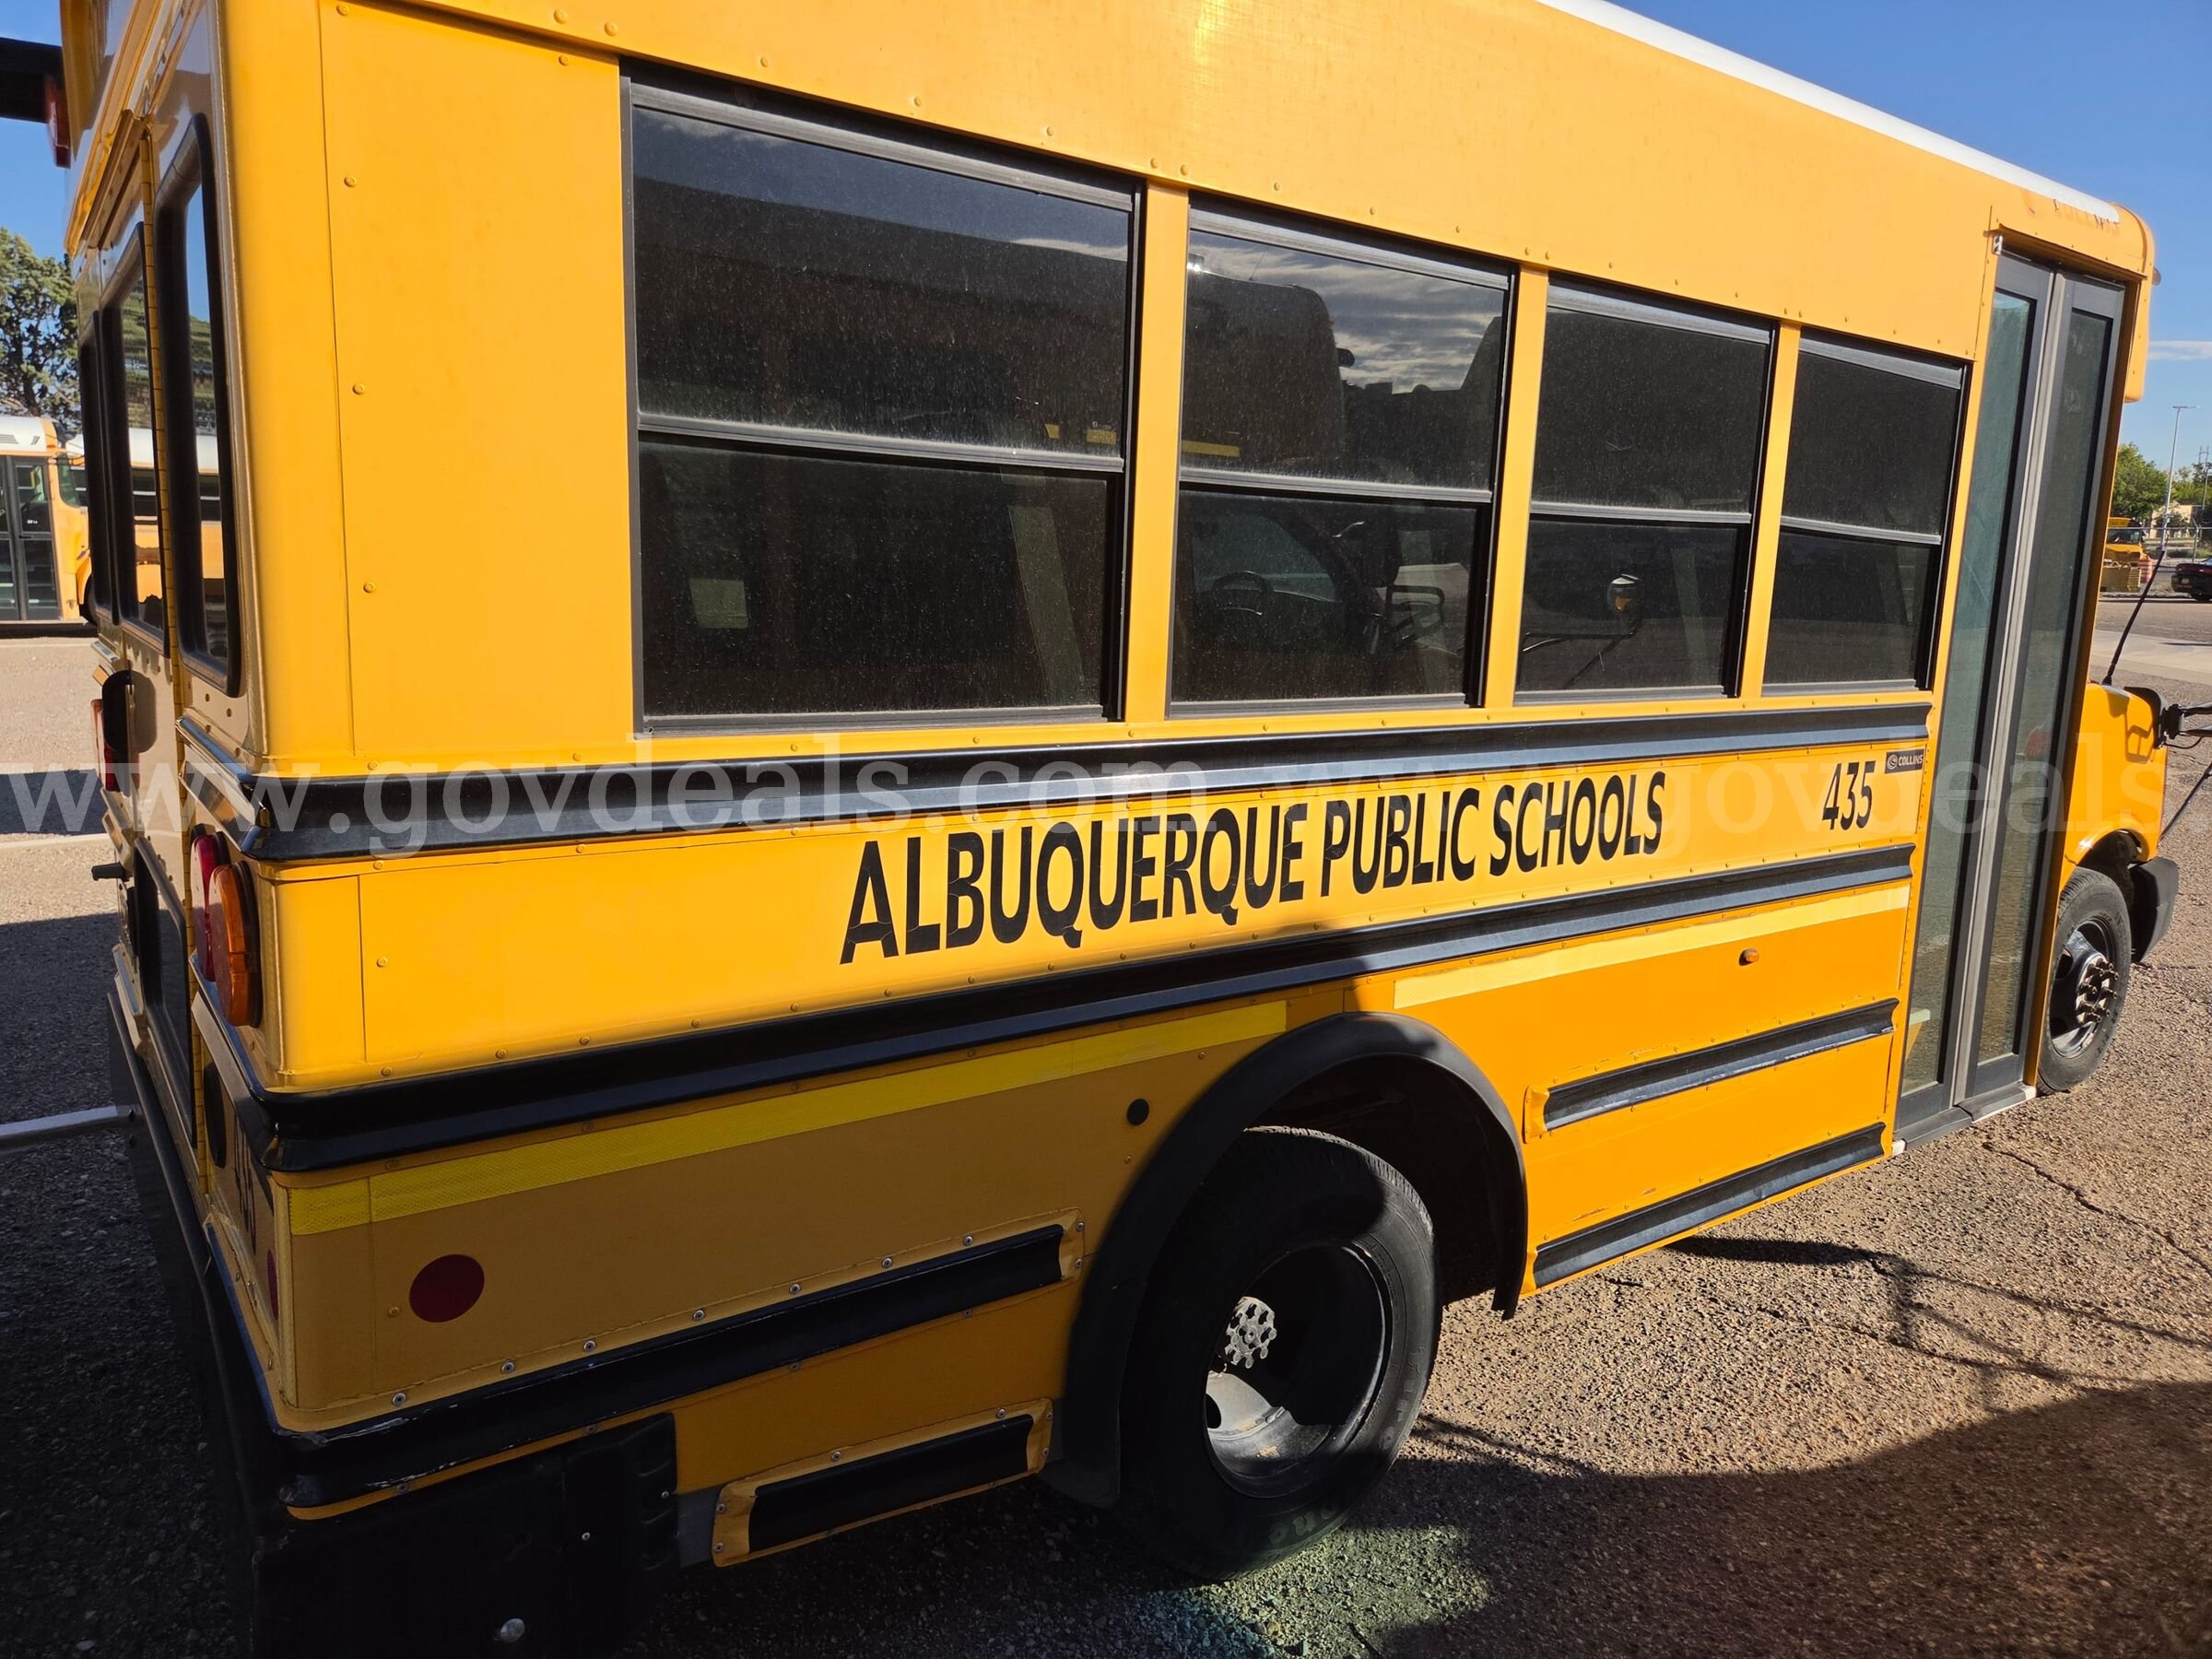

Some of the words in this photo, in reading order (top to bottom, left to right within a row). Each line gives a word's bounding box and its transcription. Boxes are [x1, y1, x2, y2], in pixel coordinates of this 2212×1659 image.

[1822, 760, 1875, 830] 435
[1898, 754, 1924, 766] COLLINS
[840, 803, 1308, 964] ALBUQUERQUE
[1320, 787, 1480, 898] PUBLIC
[1489, 771, 1666, 877] SCHOOLS
